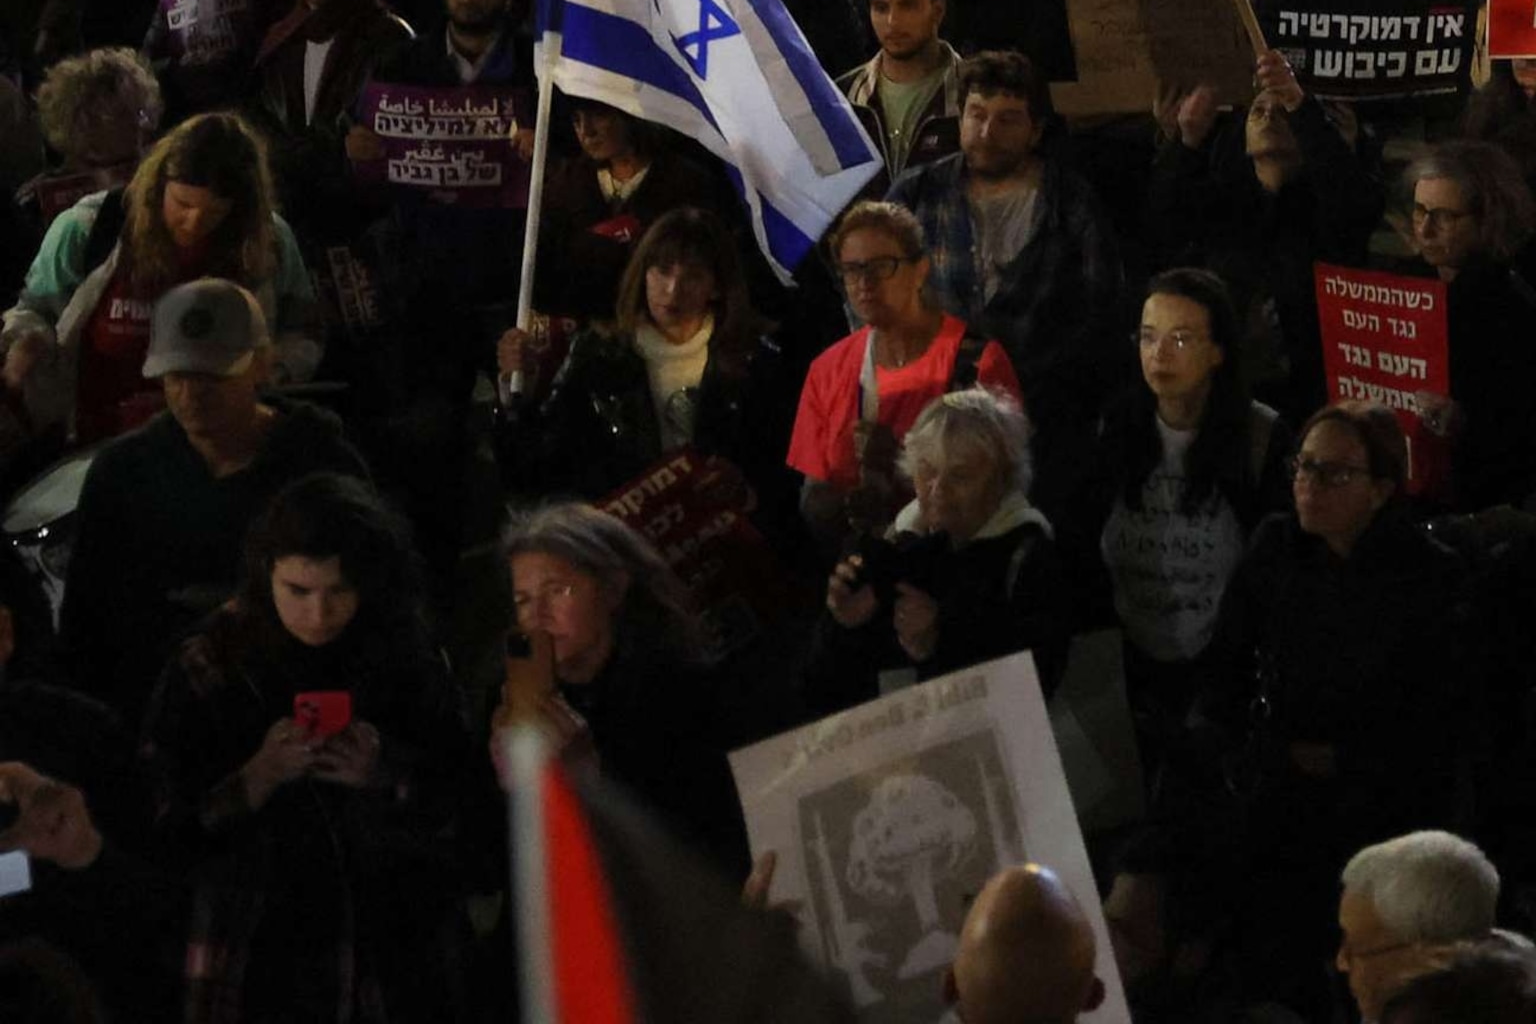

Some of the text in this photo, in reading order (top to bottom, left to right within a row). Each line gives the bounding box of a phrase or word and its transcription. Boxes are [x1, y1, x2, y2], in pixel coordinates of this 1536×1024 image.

[1277, 10, 1465, 45] אין דמוקרטיה
[1313, 47, 1462, 80] עם כיבוש
[391, 154, 498, 188] של בן גביר
[1325, 275, 1435, 312] כשהממשלה
[1342, 308, 1417, 340] נגד העם
[1337, 341, 1428, 380] העם נגד
[604, 456, 692, 517] דמוקר
